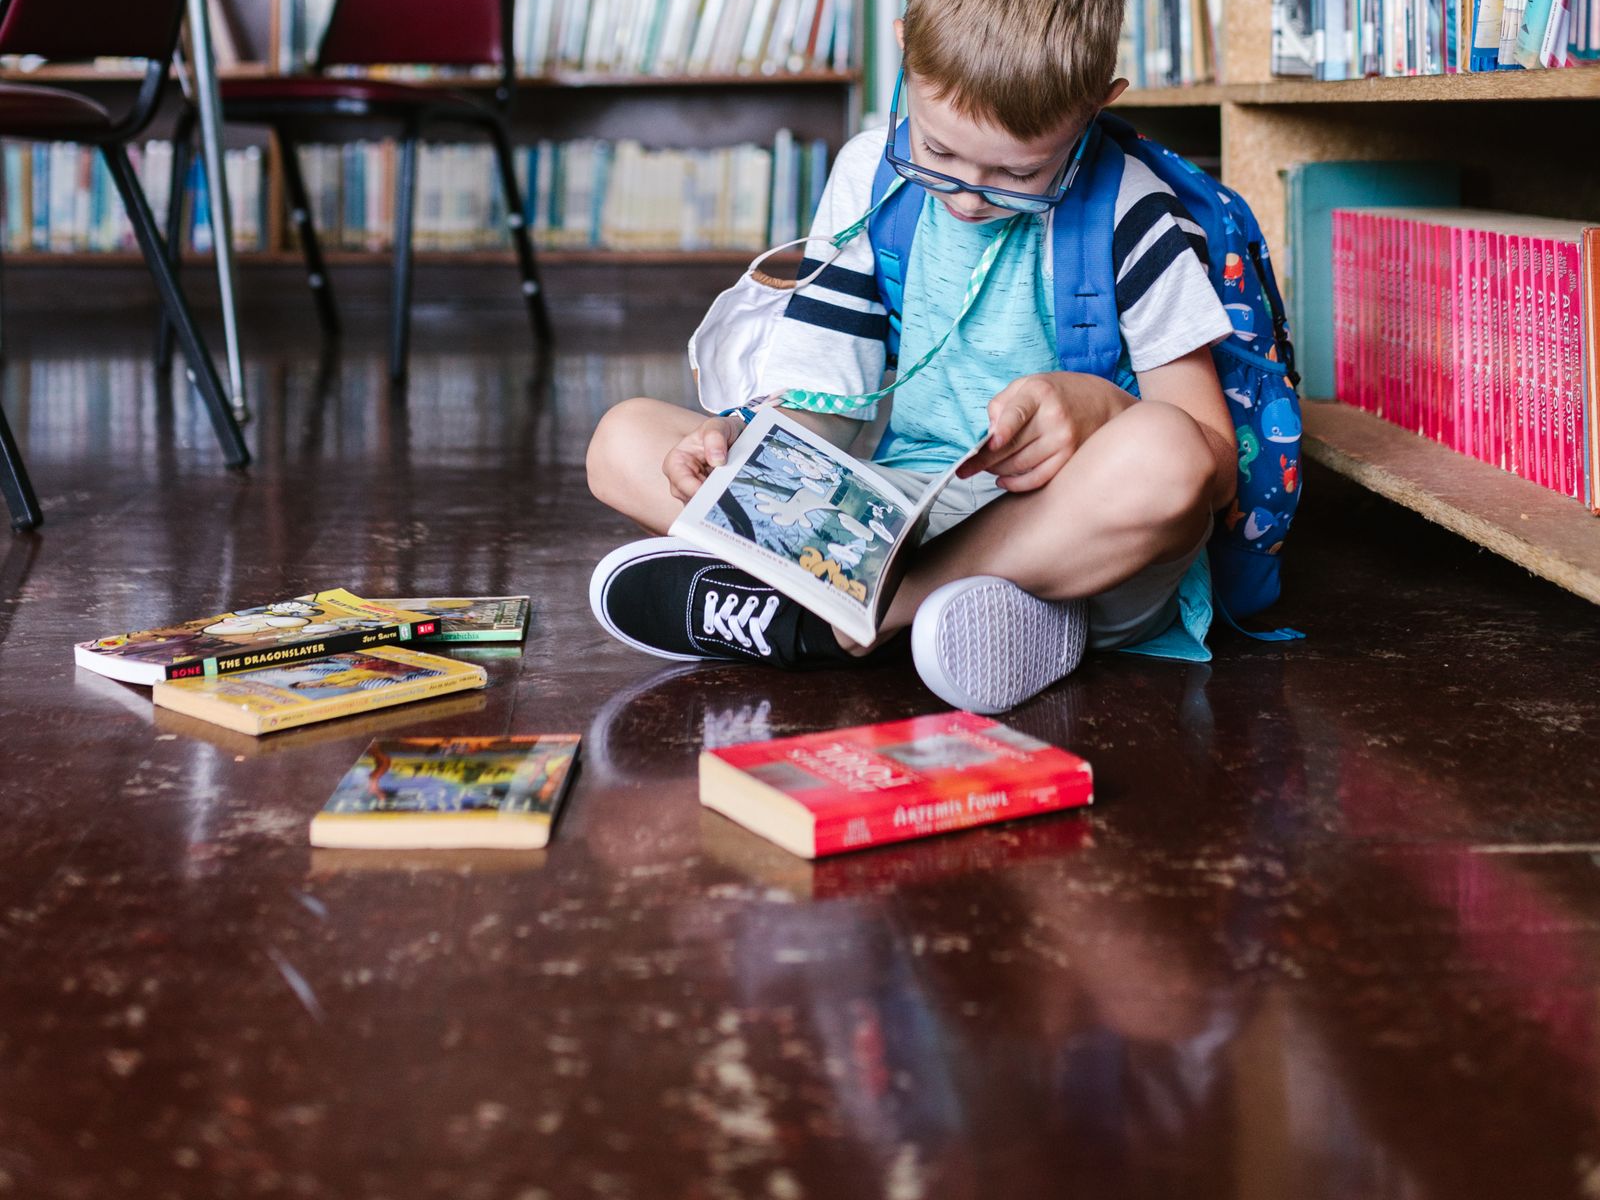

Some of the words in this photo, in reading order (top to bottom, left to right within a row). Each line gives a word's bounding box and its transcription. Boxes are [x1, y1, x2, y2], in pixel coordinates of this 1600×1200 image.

[1526, 285, 1534, 369] ARTEMIS
[1538, 290, 1546, 373] ARTEMIS
[1550, 291, 1559, 376] ARTEMIS
[1562, 294, 1572, 381] ARTEMIS
[1573, 315, 1581, 377] ARTEMIS
[171, 666, 201, 679] BONE
[219, 658, 241, 670] THE
[243, 643, 325, 666] DRAGONSLAYER
[893, 800, 963, 827] ARTEMIS
[967, 791, 1009, 812] FOWL
